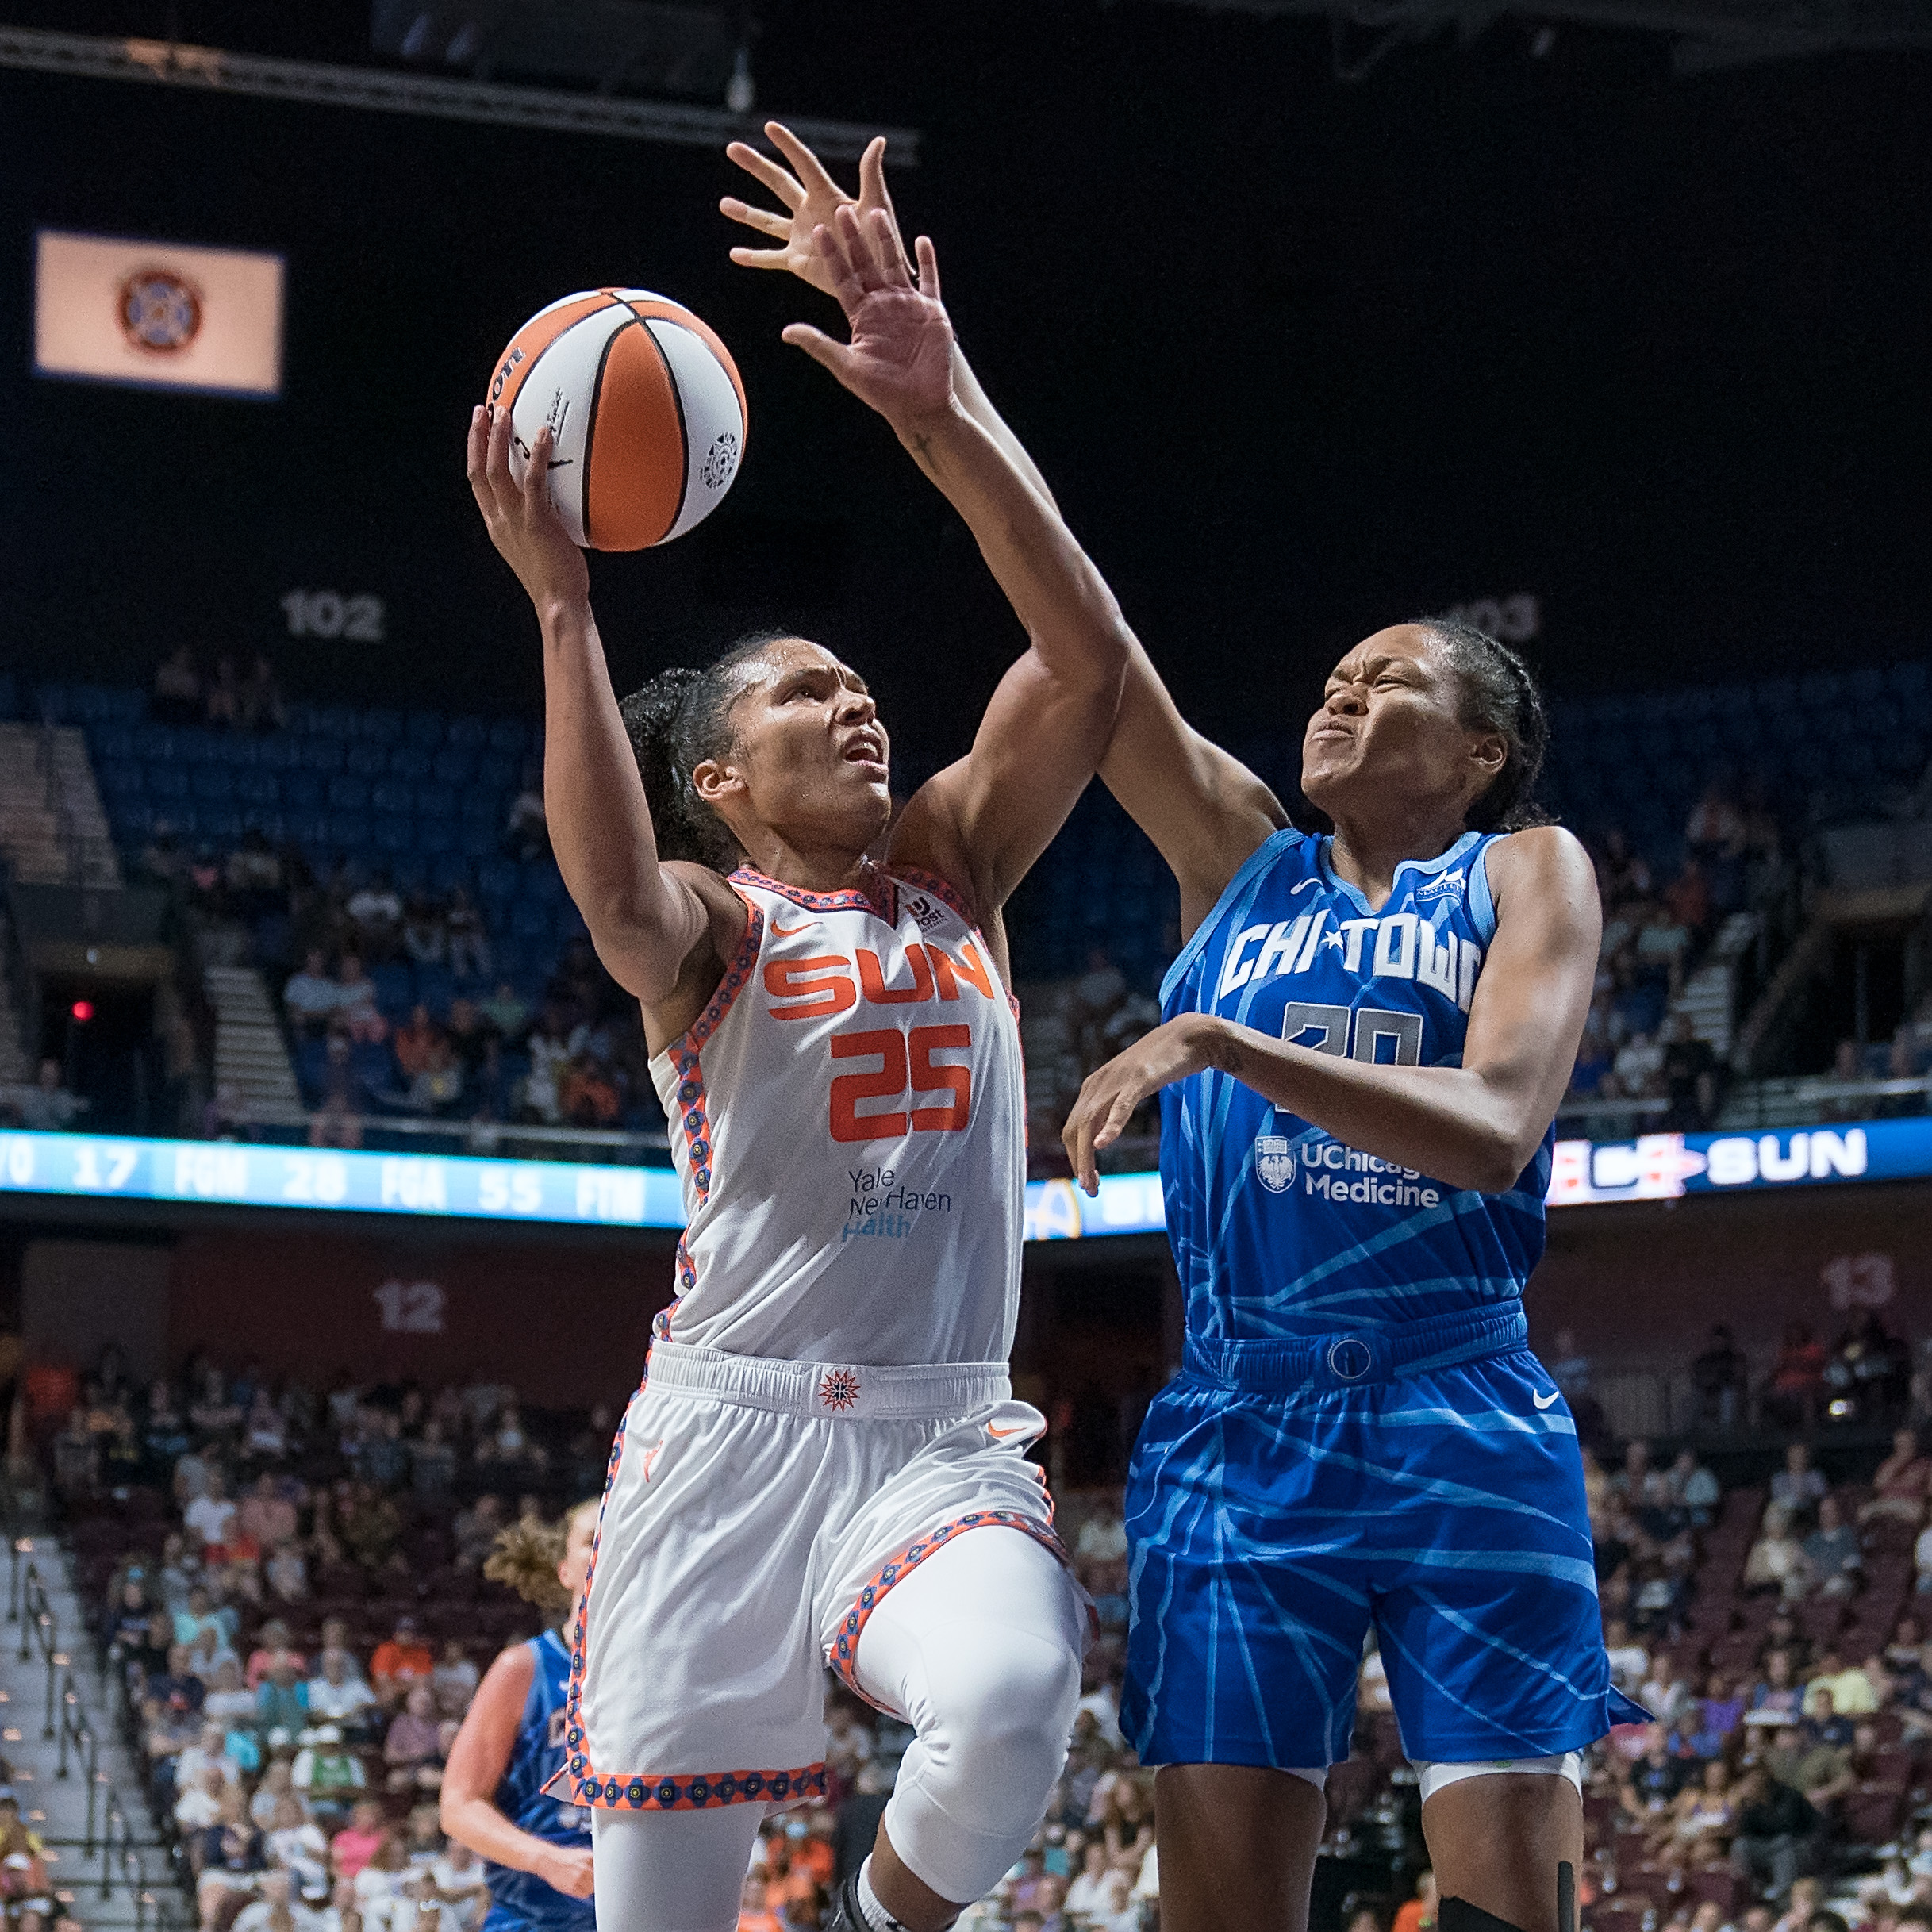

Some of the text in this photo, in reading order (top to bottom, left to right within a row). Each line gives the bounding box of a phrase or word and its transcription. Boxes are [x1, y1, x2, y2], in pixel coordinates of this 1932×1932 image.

[280, 590, 384, 640] 102
[763, 943, 995, 1020] SUN
[829, 1024, 971, 1143] 25
[72, 1145, 137, 1189] 17
[174, 1147, 248, 1196] FGM
[848, 1168, 895, 1192] Yale
[1302, 1143, 1421, 1180] UChicag
[1707, 1128, 1868, 1185] SUN
[848, 1196, 882, 1220] Ne
[1305, 1172, 1440, 1208] Medicine
[374, 1281, 444, 1331] 12
[1820, 1254, 1892, 1309] 13
